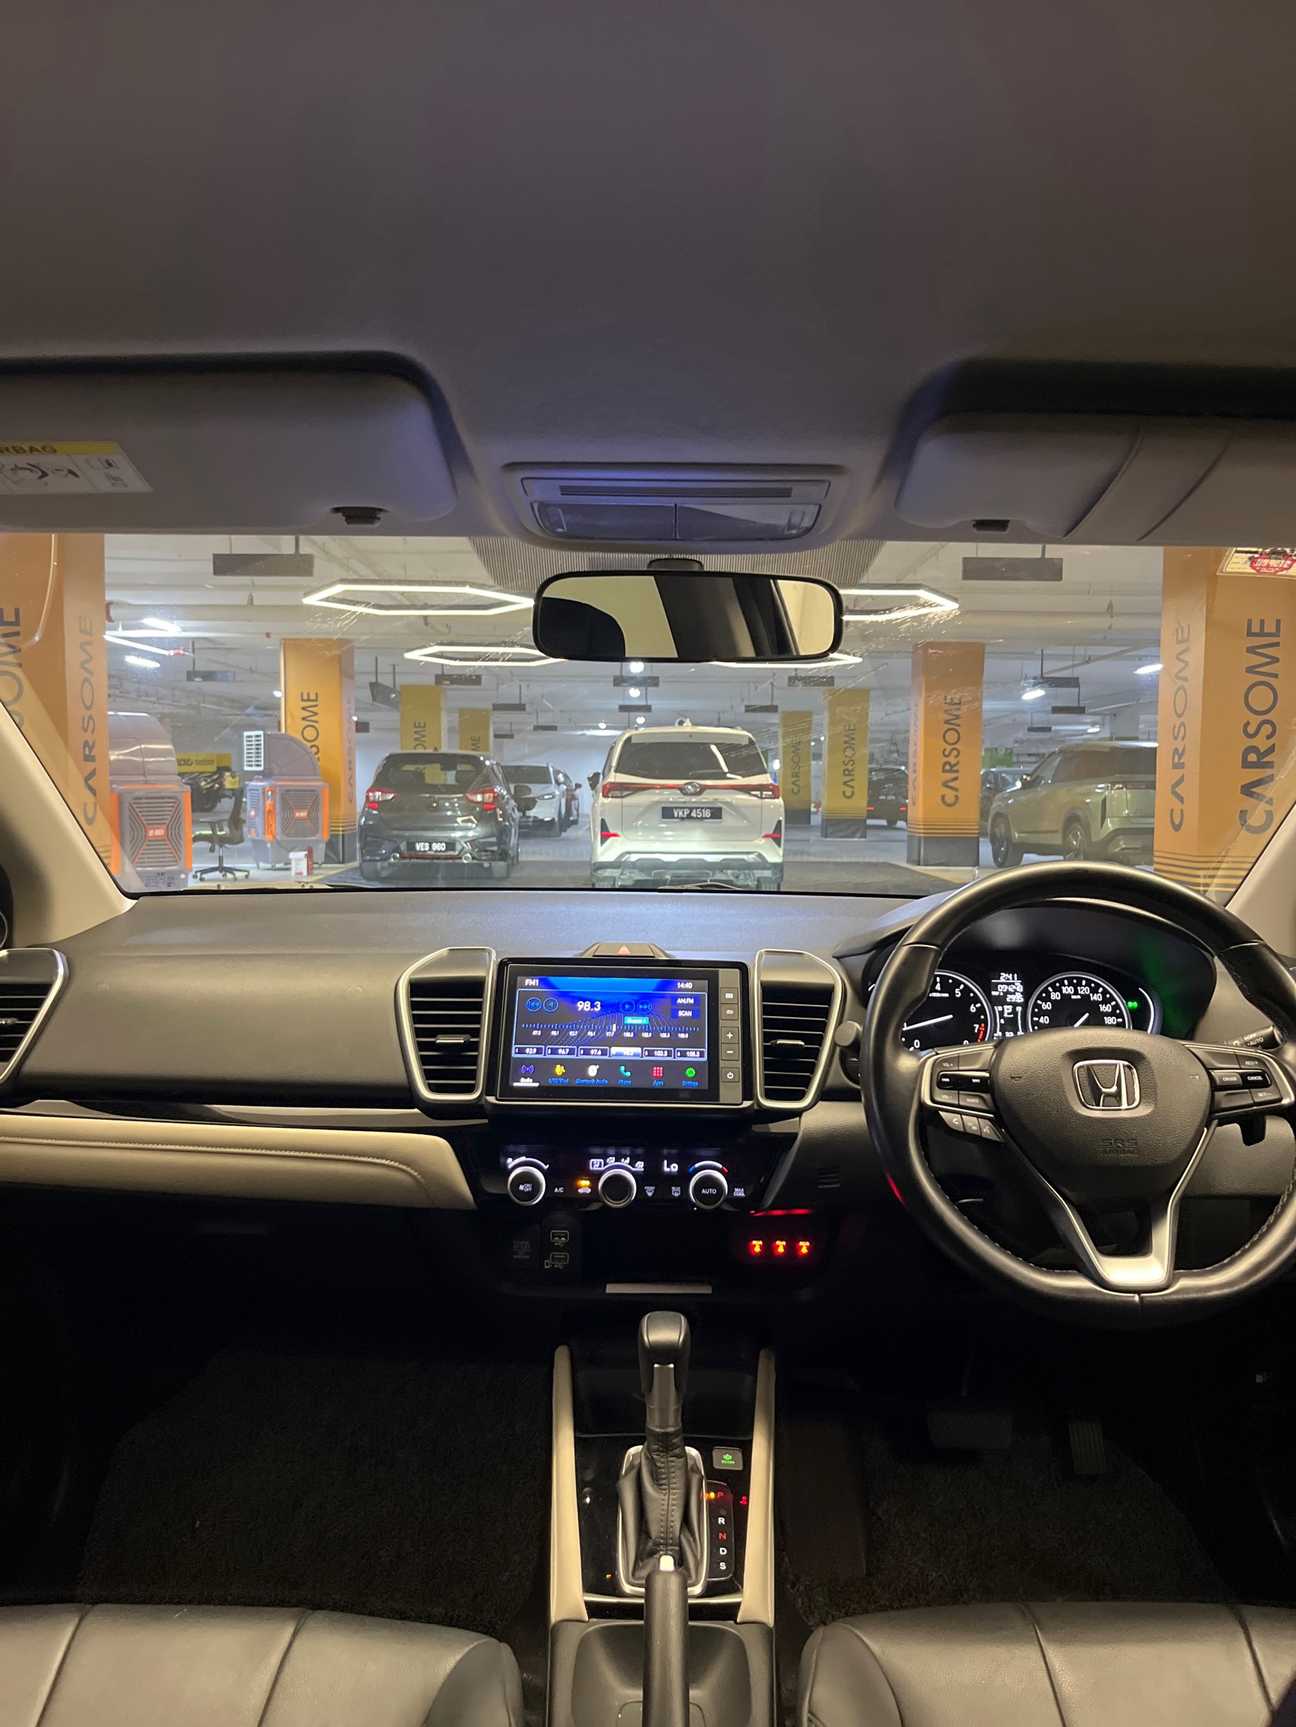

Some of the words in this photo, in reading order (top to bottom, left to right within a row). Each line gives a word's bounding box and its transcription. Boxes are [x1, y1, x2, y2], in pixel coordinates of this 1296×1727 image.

[79, 614, 97, 826] CARSOME
[1168, 622, 1191, 833] CARSOME
[1238, 618, 1281, 835] CARSOME
[941, 695, 961, 808] CARSOME
[842, 719, 857, 799] CARSOME
[673, 808, 690, 817] VKP
[955, 988, 961, 997] 5
[1061, 986, 1074, 994] 100
[1090, 993, 1102, 1001] 140
[577, 1001, 601, 1011] 98.3
[970, 1003, 976, 1012] 6
[1042, 1002, 1052, 1010] 60
[1099, 1004, 1112, 1012] 160
[1039, 1016, 1049, 1024] 40
[974, 1024, 979, 1032] 7
[914, 1040, 920, 1048] 0
[664, 1160, 679, 1172] Lo
[718, 1516, 726, 1525] R
[719, 1532, 727, 1540] N
[719, 1547, 728, 1555] D
[719, 1561, 727, 1570] S
